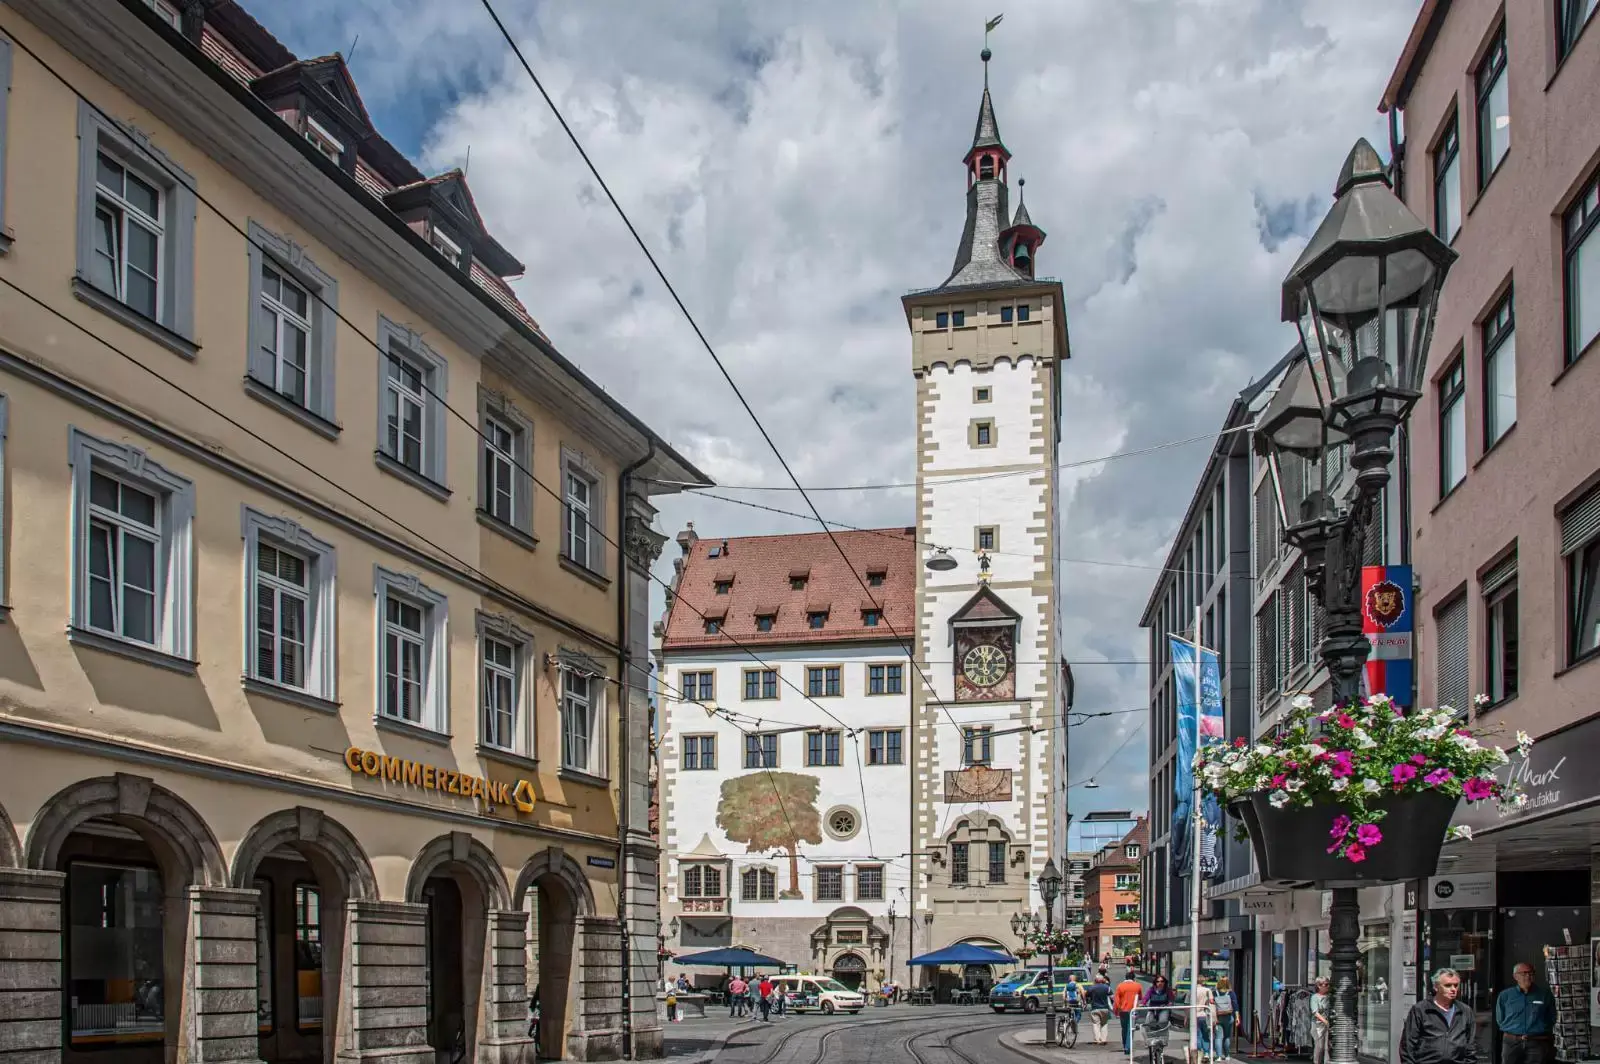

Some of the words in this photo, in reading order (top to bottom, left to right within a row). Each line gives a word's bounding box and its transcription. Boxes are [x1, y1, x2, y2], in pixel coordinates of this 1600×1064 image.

[345, 747, 510, 805] COMMERZBANK
[1516, 756, 1566, 786] Marx
[1407, 890, 1415, 906] 13
